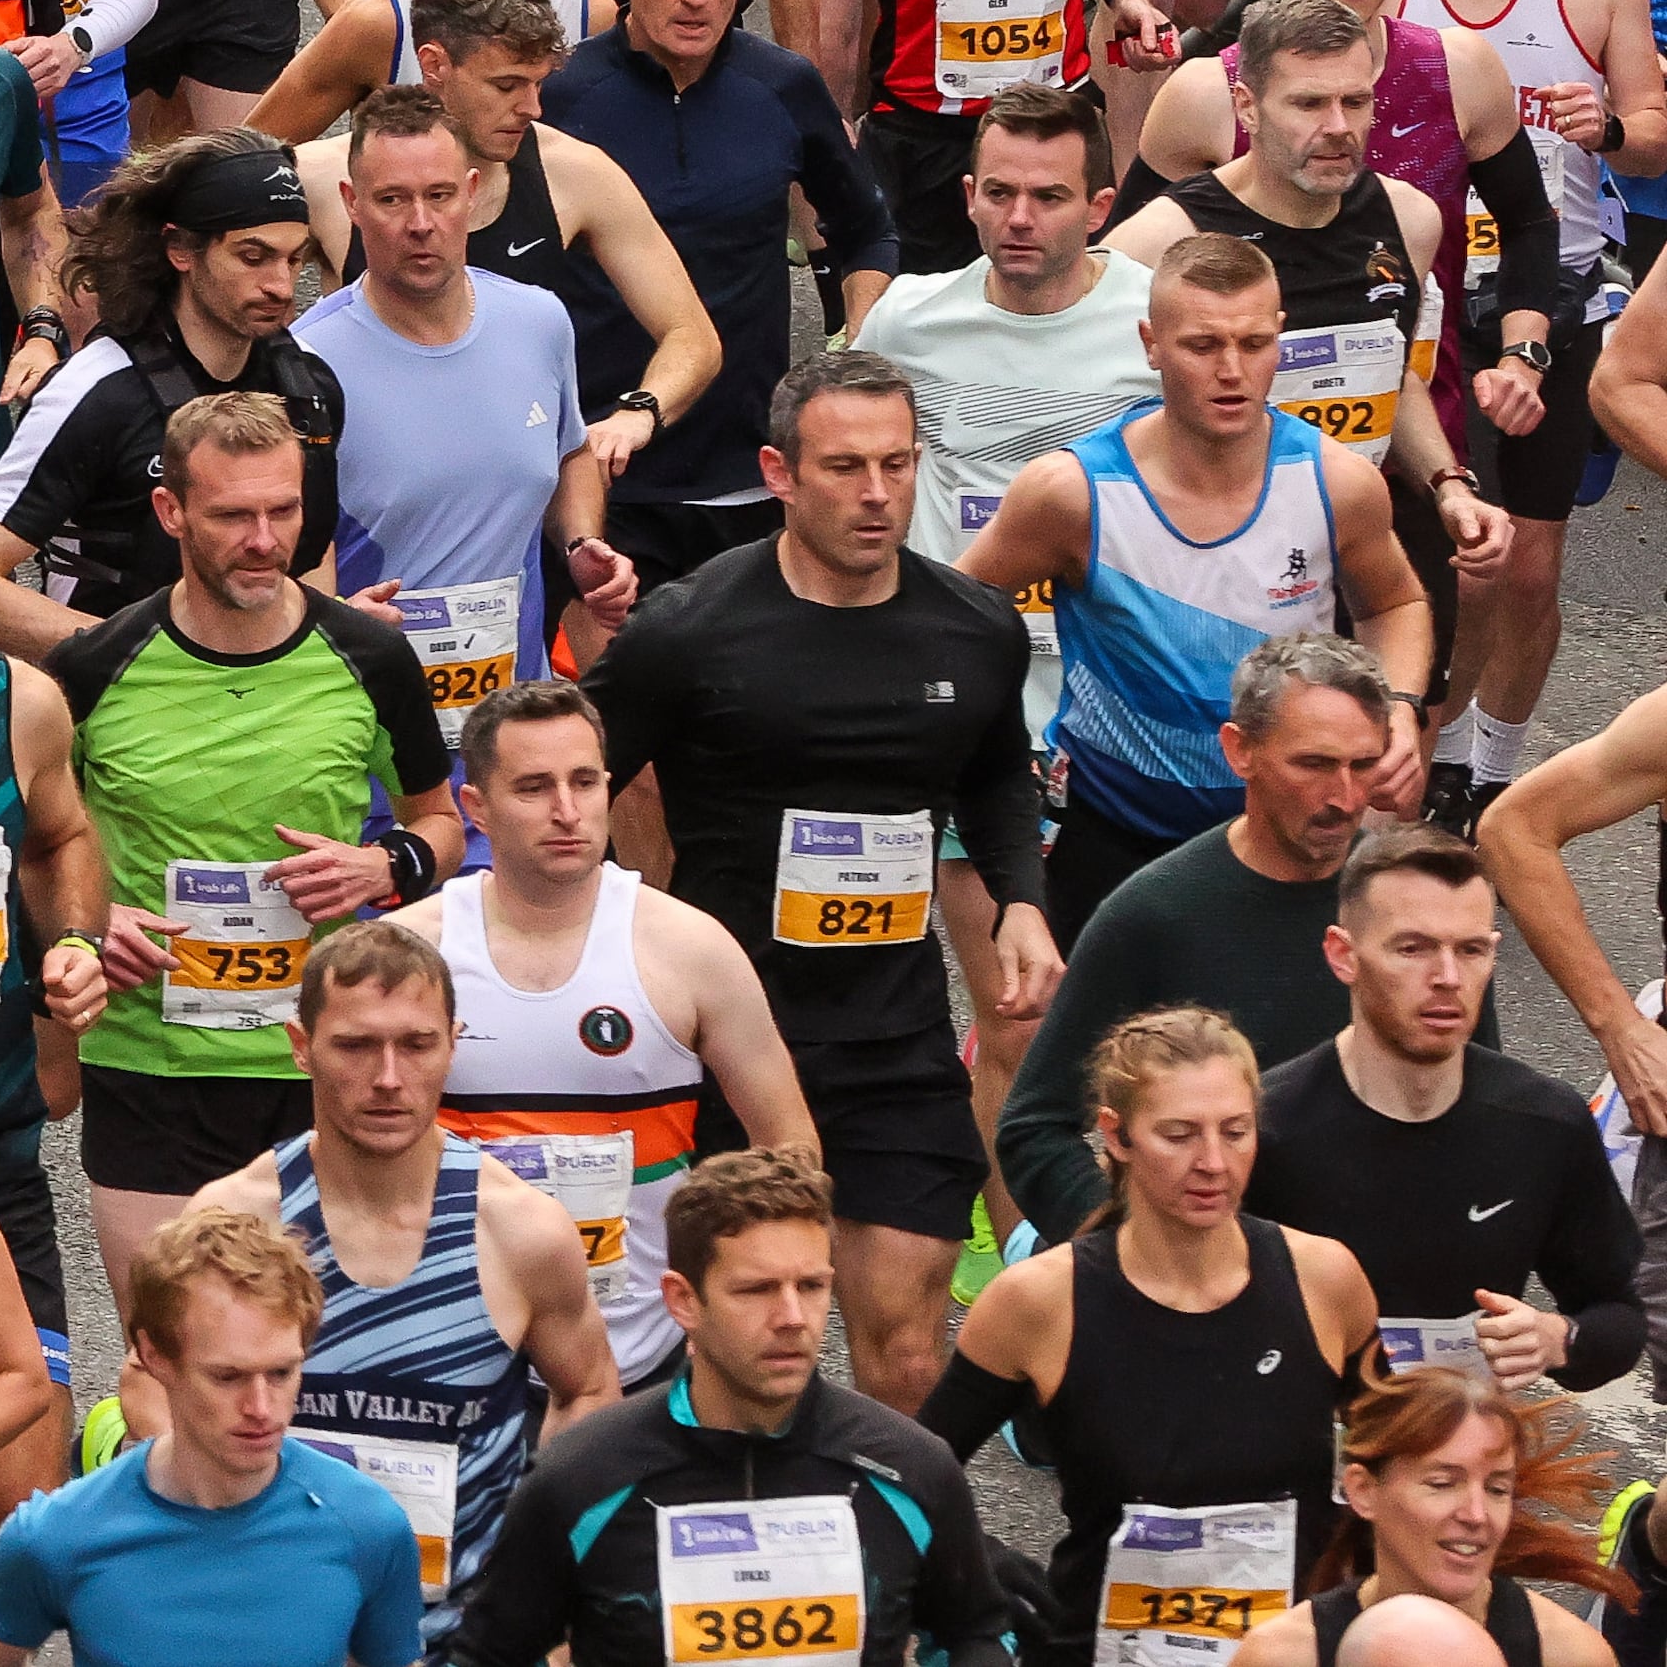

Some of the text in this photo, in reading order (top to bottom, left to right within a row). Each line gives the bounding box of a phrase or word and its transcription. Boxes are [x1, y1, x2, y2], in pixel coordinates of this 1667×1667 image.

[959, 21, 1052, 56] 1054
[817, 900, 894, 936] 821
[206, 947, 292, 982] 753
[344, 1390, 454, 1425] VALLEY
[695, 1605, 835, 1651] 3862
